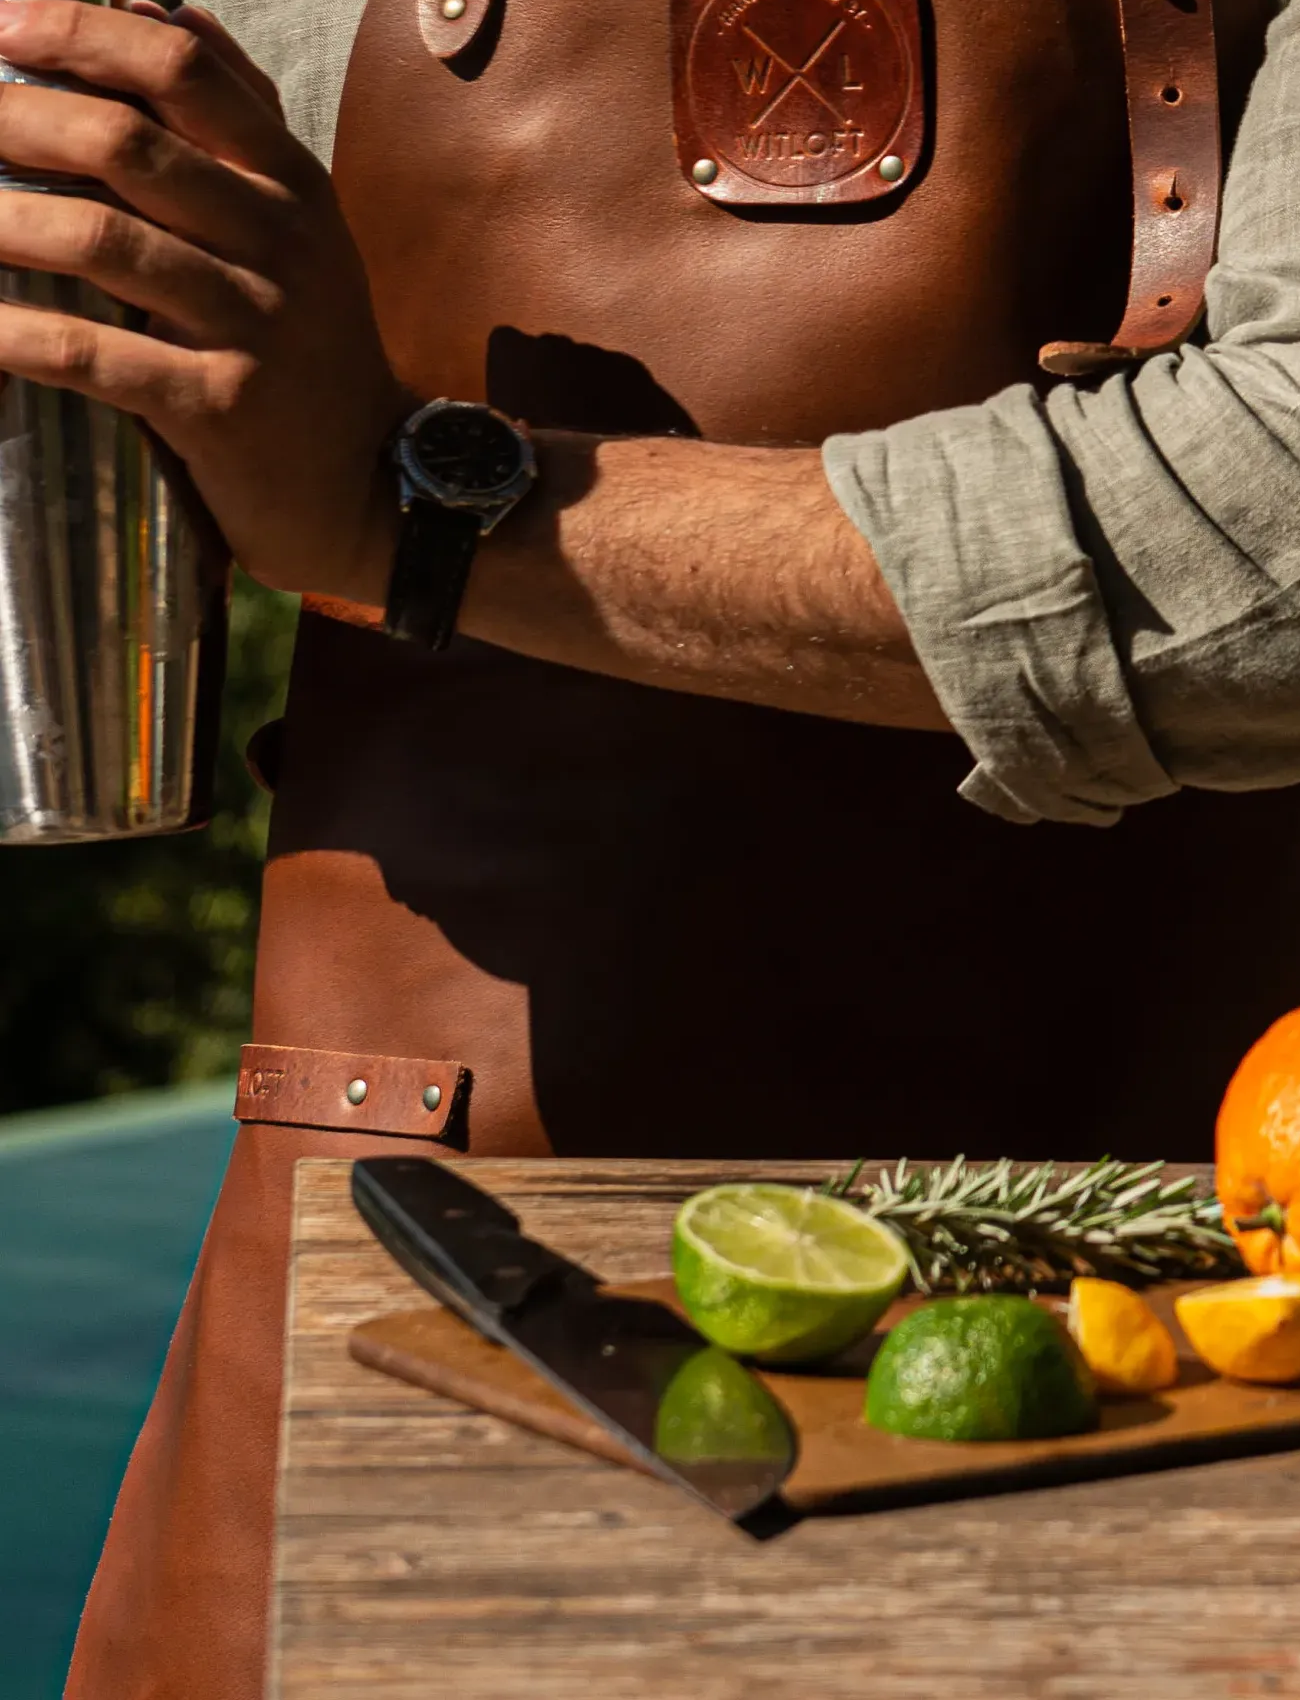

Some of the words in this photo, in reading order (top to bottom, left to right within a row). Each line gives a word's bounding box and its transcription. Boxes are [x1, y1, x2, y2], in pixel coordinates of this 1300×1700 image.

[732, 54, 774, 95] W
[841, 53, 864, 91] L
[735, 129, 865, 162] WITLOFT
